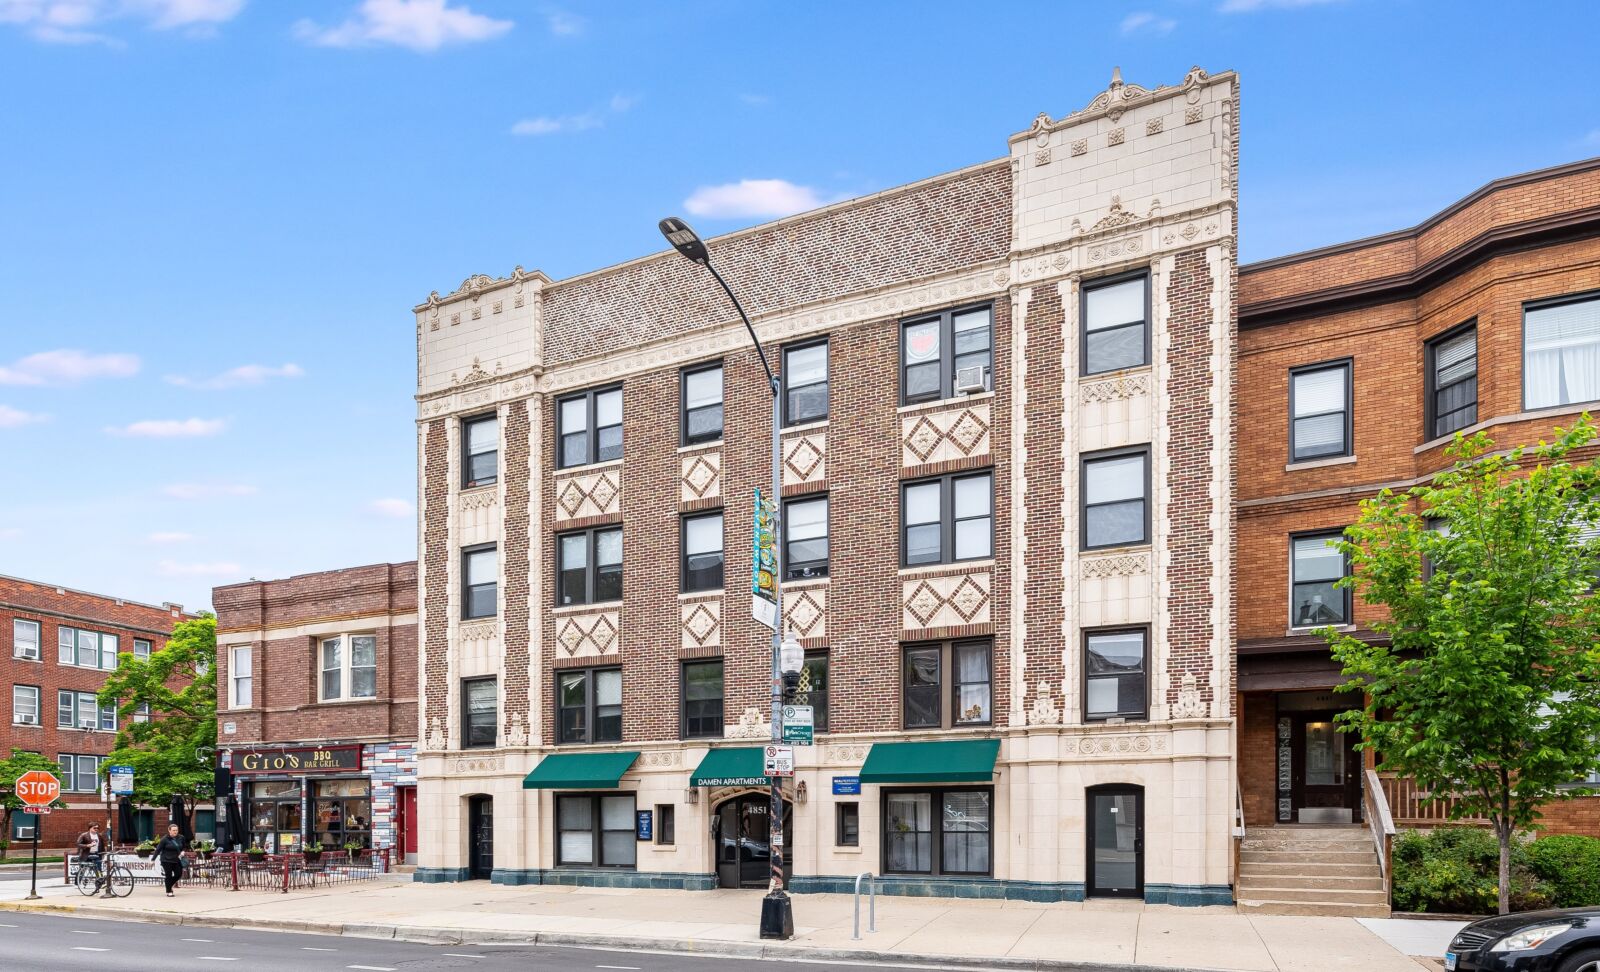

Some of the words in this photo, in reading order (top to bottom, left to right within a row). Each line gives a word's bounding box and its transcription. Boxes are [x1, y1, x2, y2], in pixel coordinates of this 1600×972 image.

[314, 751, 331, 760] BBQ
[304, 761, 317, 769] BAR
[320, 760, 340, 768] GRILL
[723, 777, 767, 785] APARTMENTS
[19, 781, 57, 796] STOP
[748, 806, 767, 814] 4851
